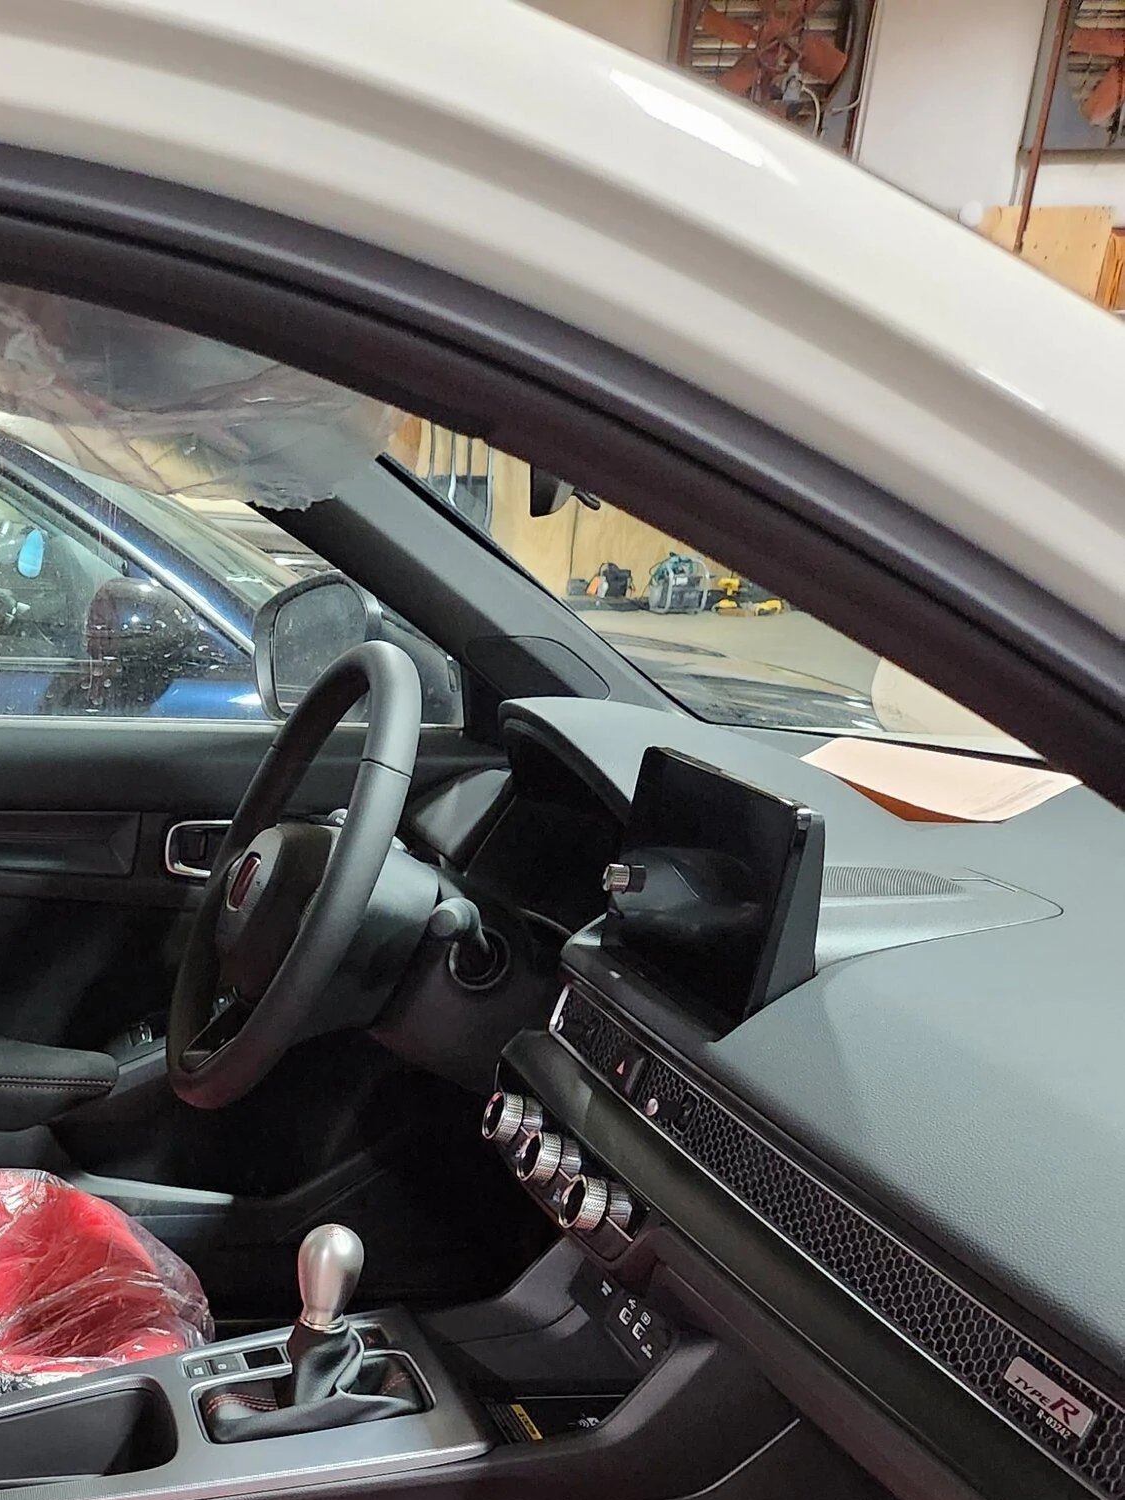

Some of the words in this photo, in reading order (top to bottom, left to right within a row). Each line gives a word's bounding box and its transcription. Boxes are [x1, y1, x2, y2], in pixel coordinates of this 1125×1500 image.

[1007, 1387, 1032, 1411] CIVIC
[1015, 1376, 1050, 1407] TYPE
[1049, 1397, 1081, 1426] R
